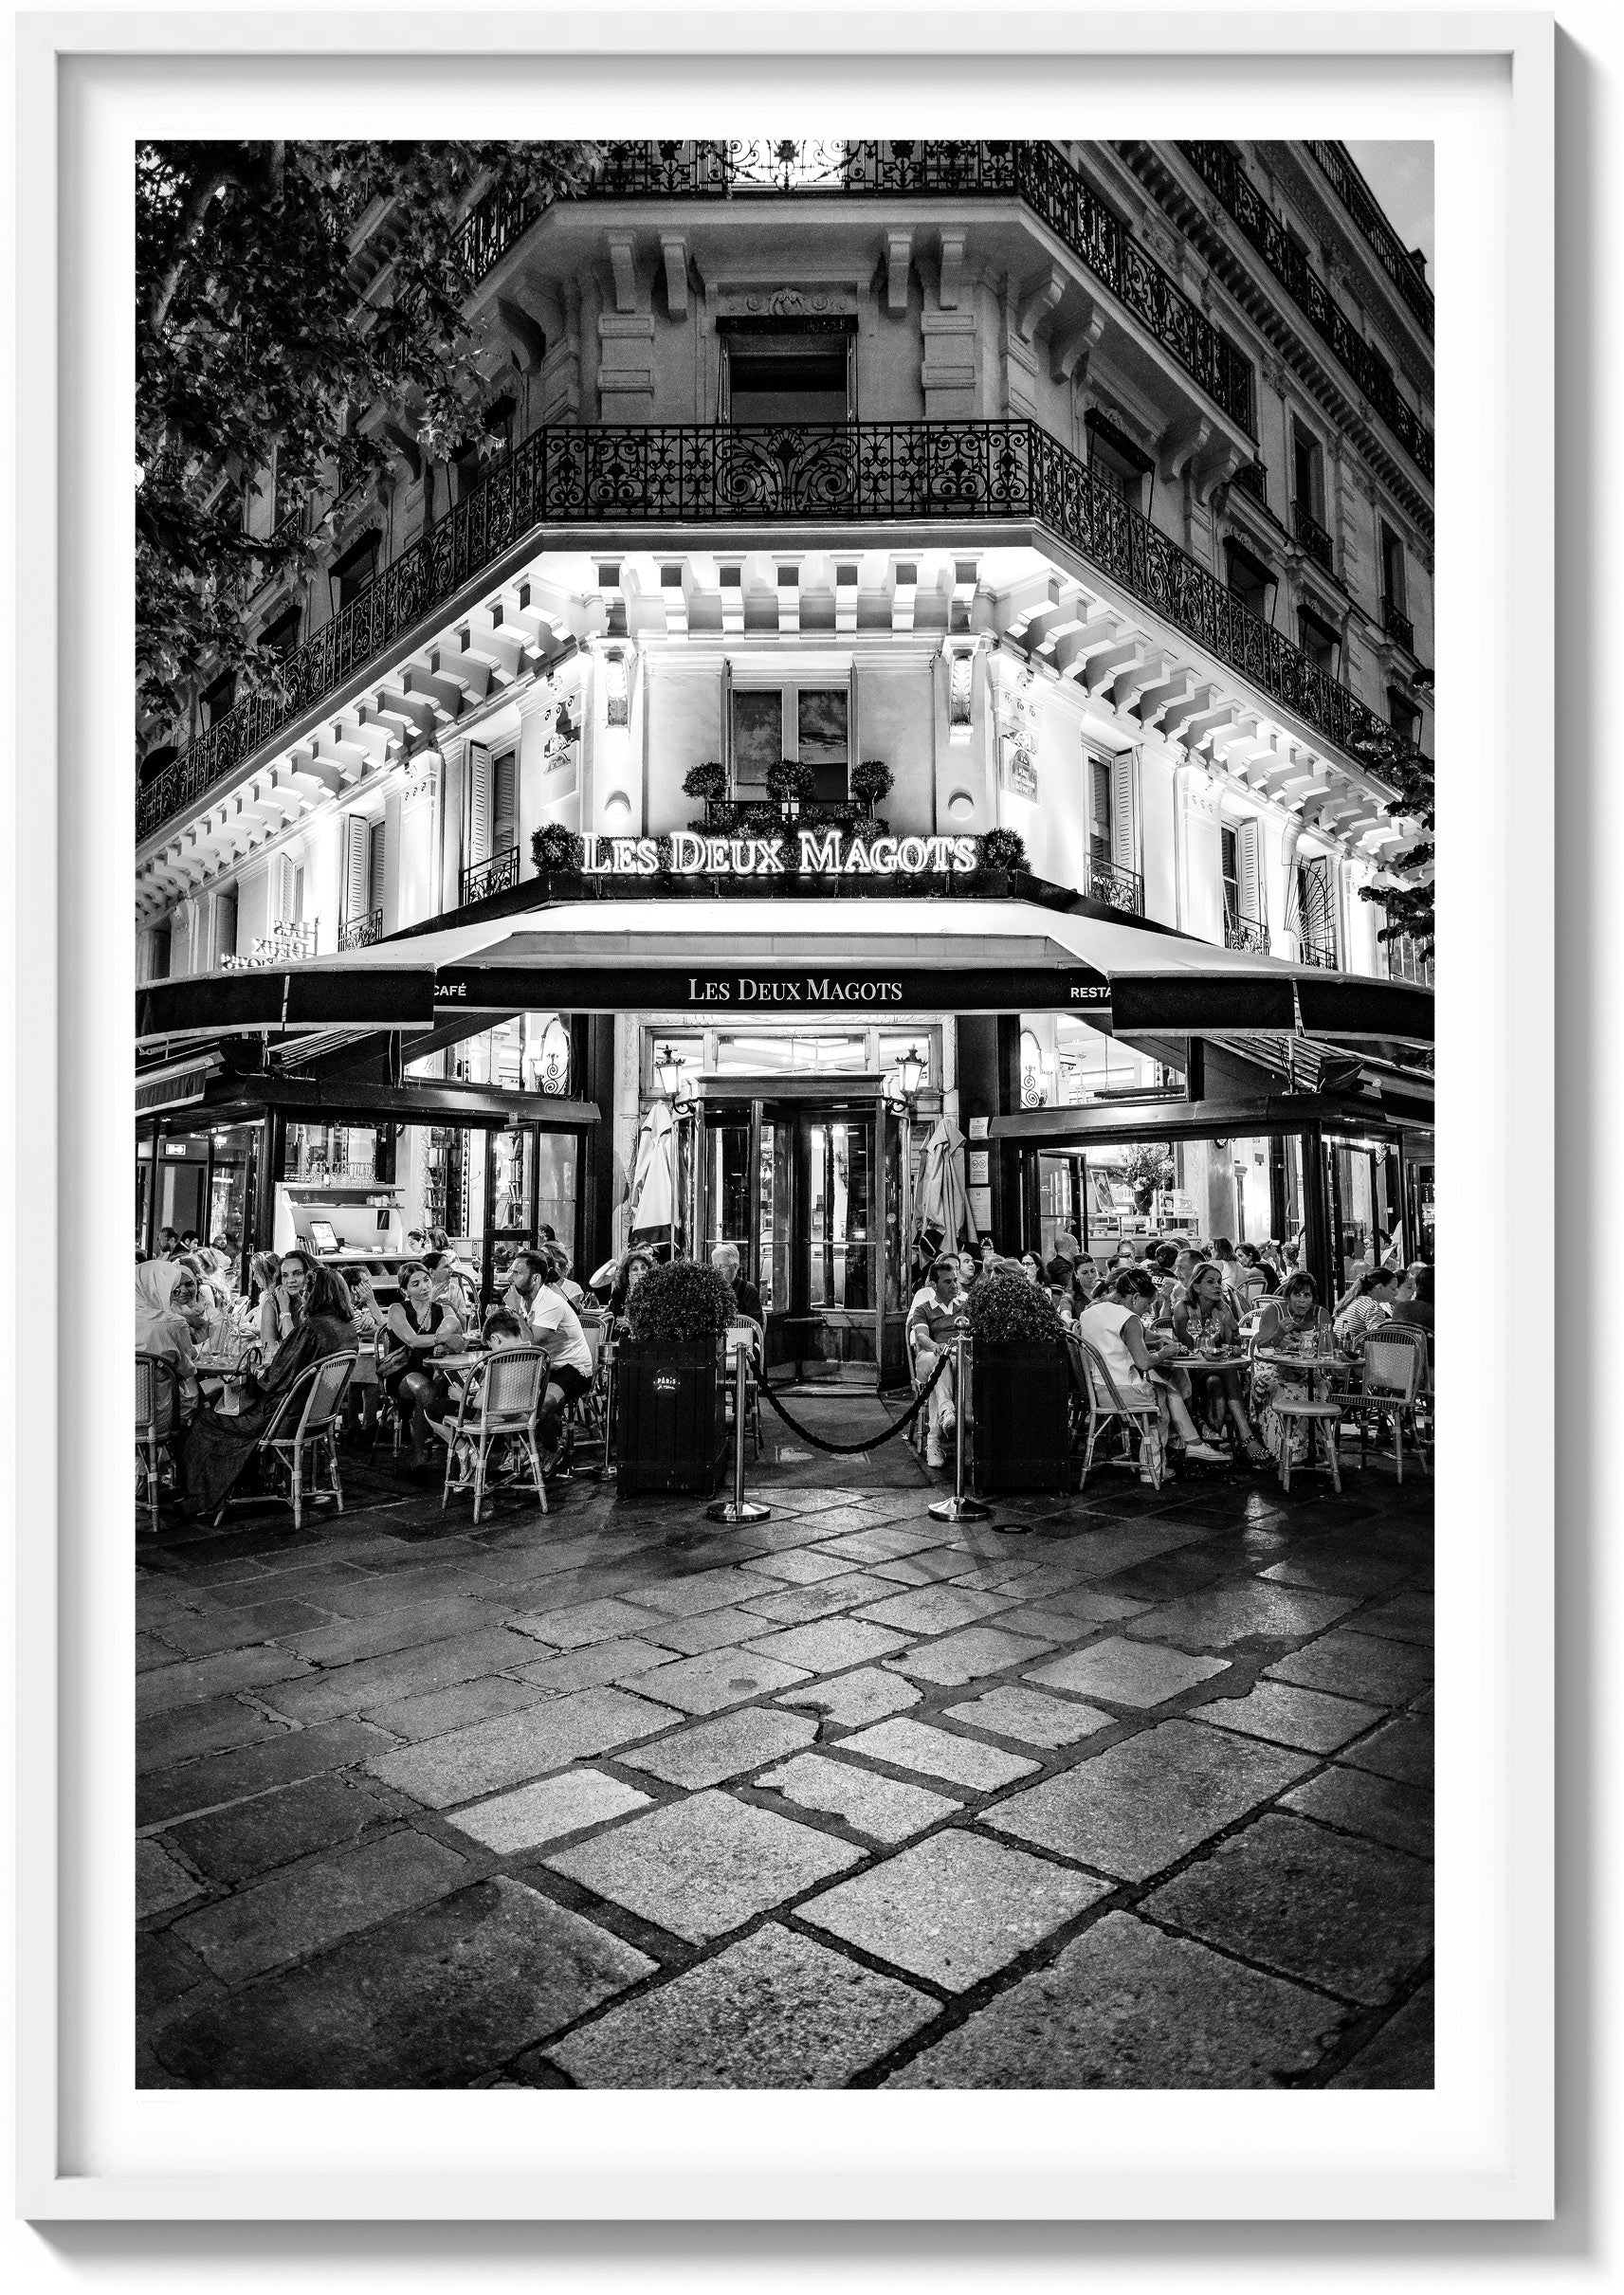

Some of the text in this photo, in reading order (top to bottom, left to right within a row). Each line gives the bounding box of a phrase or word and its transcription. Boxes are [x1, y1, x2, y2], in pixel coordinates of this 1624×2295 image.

[579, 829, 978, 874] LES DEUX MAGOTS
[688, 978, 903, 1000] LES DEUX MAGOTS
